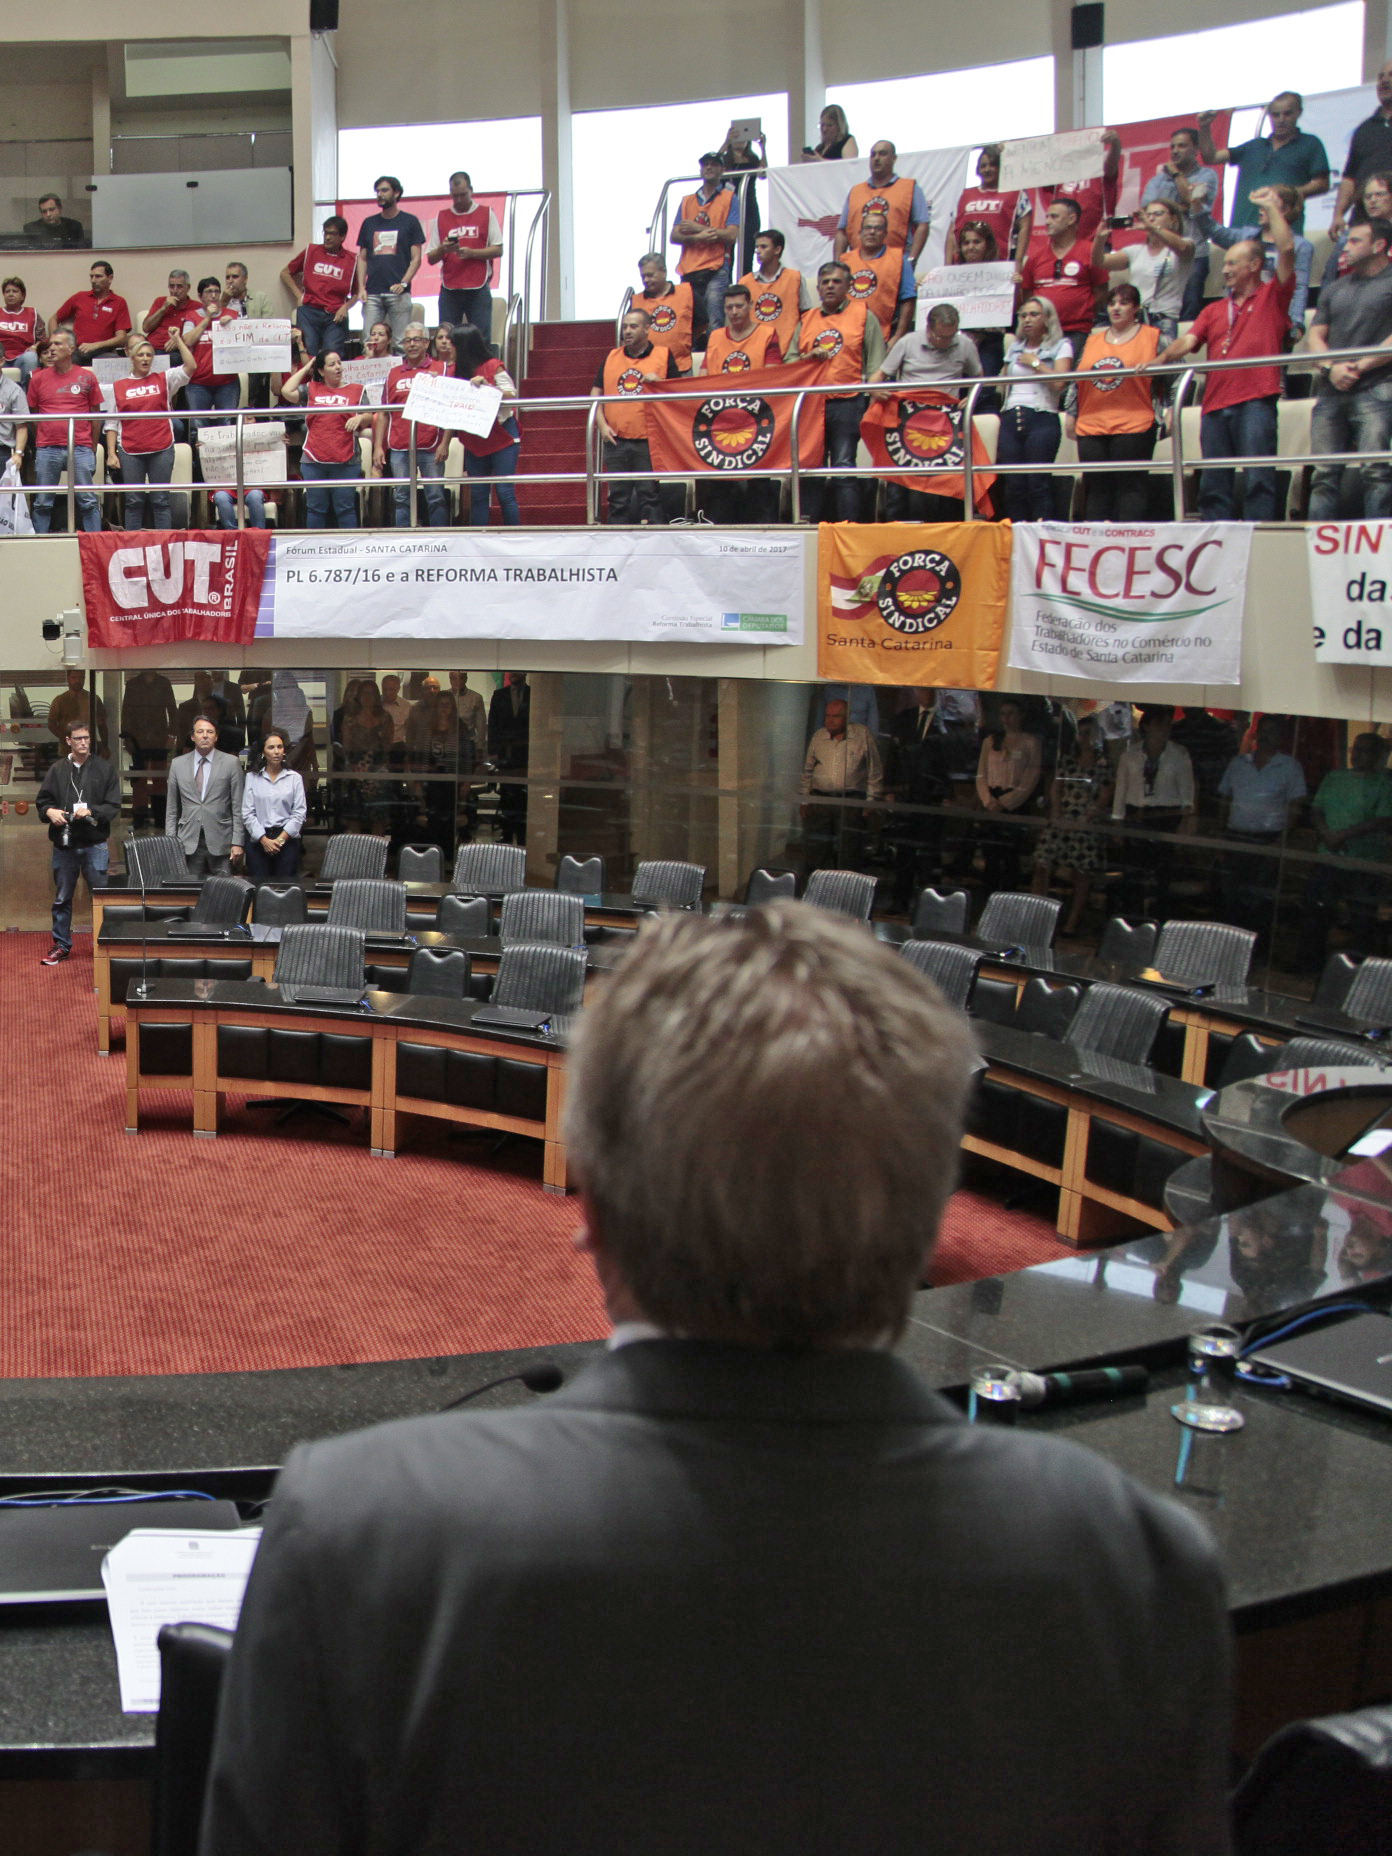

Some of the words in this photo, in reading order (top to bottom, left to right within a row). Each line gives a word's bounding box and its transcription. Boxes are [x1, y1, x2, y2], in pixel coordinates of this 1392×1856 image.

[965, 200, 1000, 212] CUT
[314, 263, 341, 277] CUT
[848, 286, 877, 299] INDICAL
[234, 332, 254, 343] FIM
[343, 363, 382, 373] alhadores
[126, 385, 156, 397] CUT
[396, 378, 413, 390] CU
[314, 395, 346, 405] CUT
[702, 397, 761, 419] FORÇA
[218, 430, 265, 440] Trabador
[695, 433, 771, 469] SINDICAL
[1072, 527, 1091, 536] CUT
[1105, 529, 1156, 538] CONTRACS
[1314, 524, 1392, 555] SIN
[286, 545, 316, 555] Fórum
[318, 545, 357, 555] Estadual
[365, 545, 397, 554] SANTA
[399, 544, 448, 553] CATARINA
[890, 553, 950, 578] FORÇA
[1035, 538, 1223, 600] FECESC
[108, 541, 221, 609] CUT
[223, 540, 238, 610] BRASIL
[286, 570, 304, 583] PL
[308, 568, 381, 585] 6.787/16
[385, 572, 395, 582] e
[400, 572, 409, 582] a
[415, 567, 498, 582] REFORMA
[503, 567, 618, 582] TRABALHISTA
[143, 611, 166, 620] ÚNICA
[182, 608, 231, 618] TABALHADORES
[878, 596, 957, 632] SINDICAL
[1036, 610, 1092, 632] Federação
[1095, 619, 1117, 633] dos
[827, 634, 876, 648] Santa
[881, 638, 952, 650] Catarina
[1035, 625, 1109, 648] Trabalhadores
[1113, 639, 1128, 649] no
[1131, 634, 1190, 648] Comércio
[1194, 637, 1211, 648] no
[1343, 620, 1382, 651] da
[1032, 639, 1069, 656] Estado
[1070, 644, 1083, 658] de
[1086, 648, 1118, 663] Santa
[1122, 650, 1174, 664] Catarina
